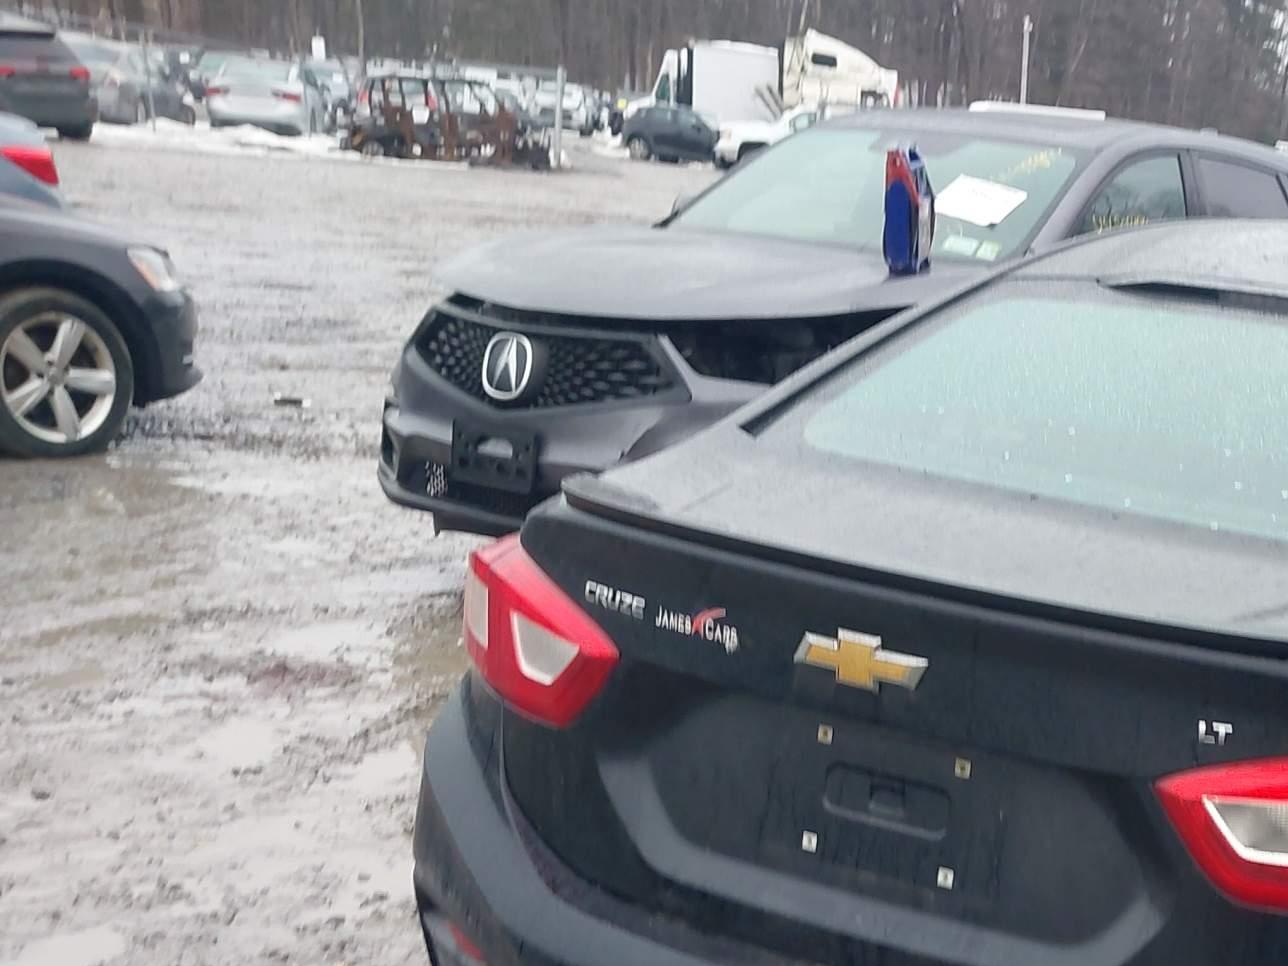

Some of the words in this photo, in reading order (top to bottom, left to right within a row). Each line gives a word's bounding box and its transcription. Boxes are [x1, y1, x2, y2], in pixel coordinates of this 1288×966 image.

[584, 580, 646, 620] CRUZE
[655, 604, 692, 636] JAMES
[1198, 719, 1233, 746] LT
